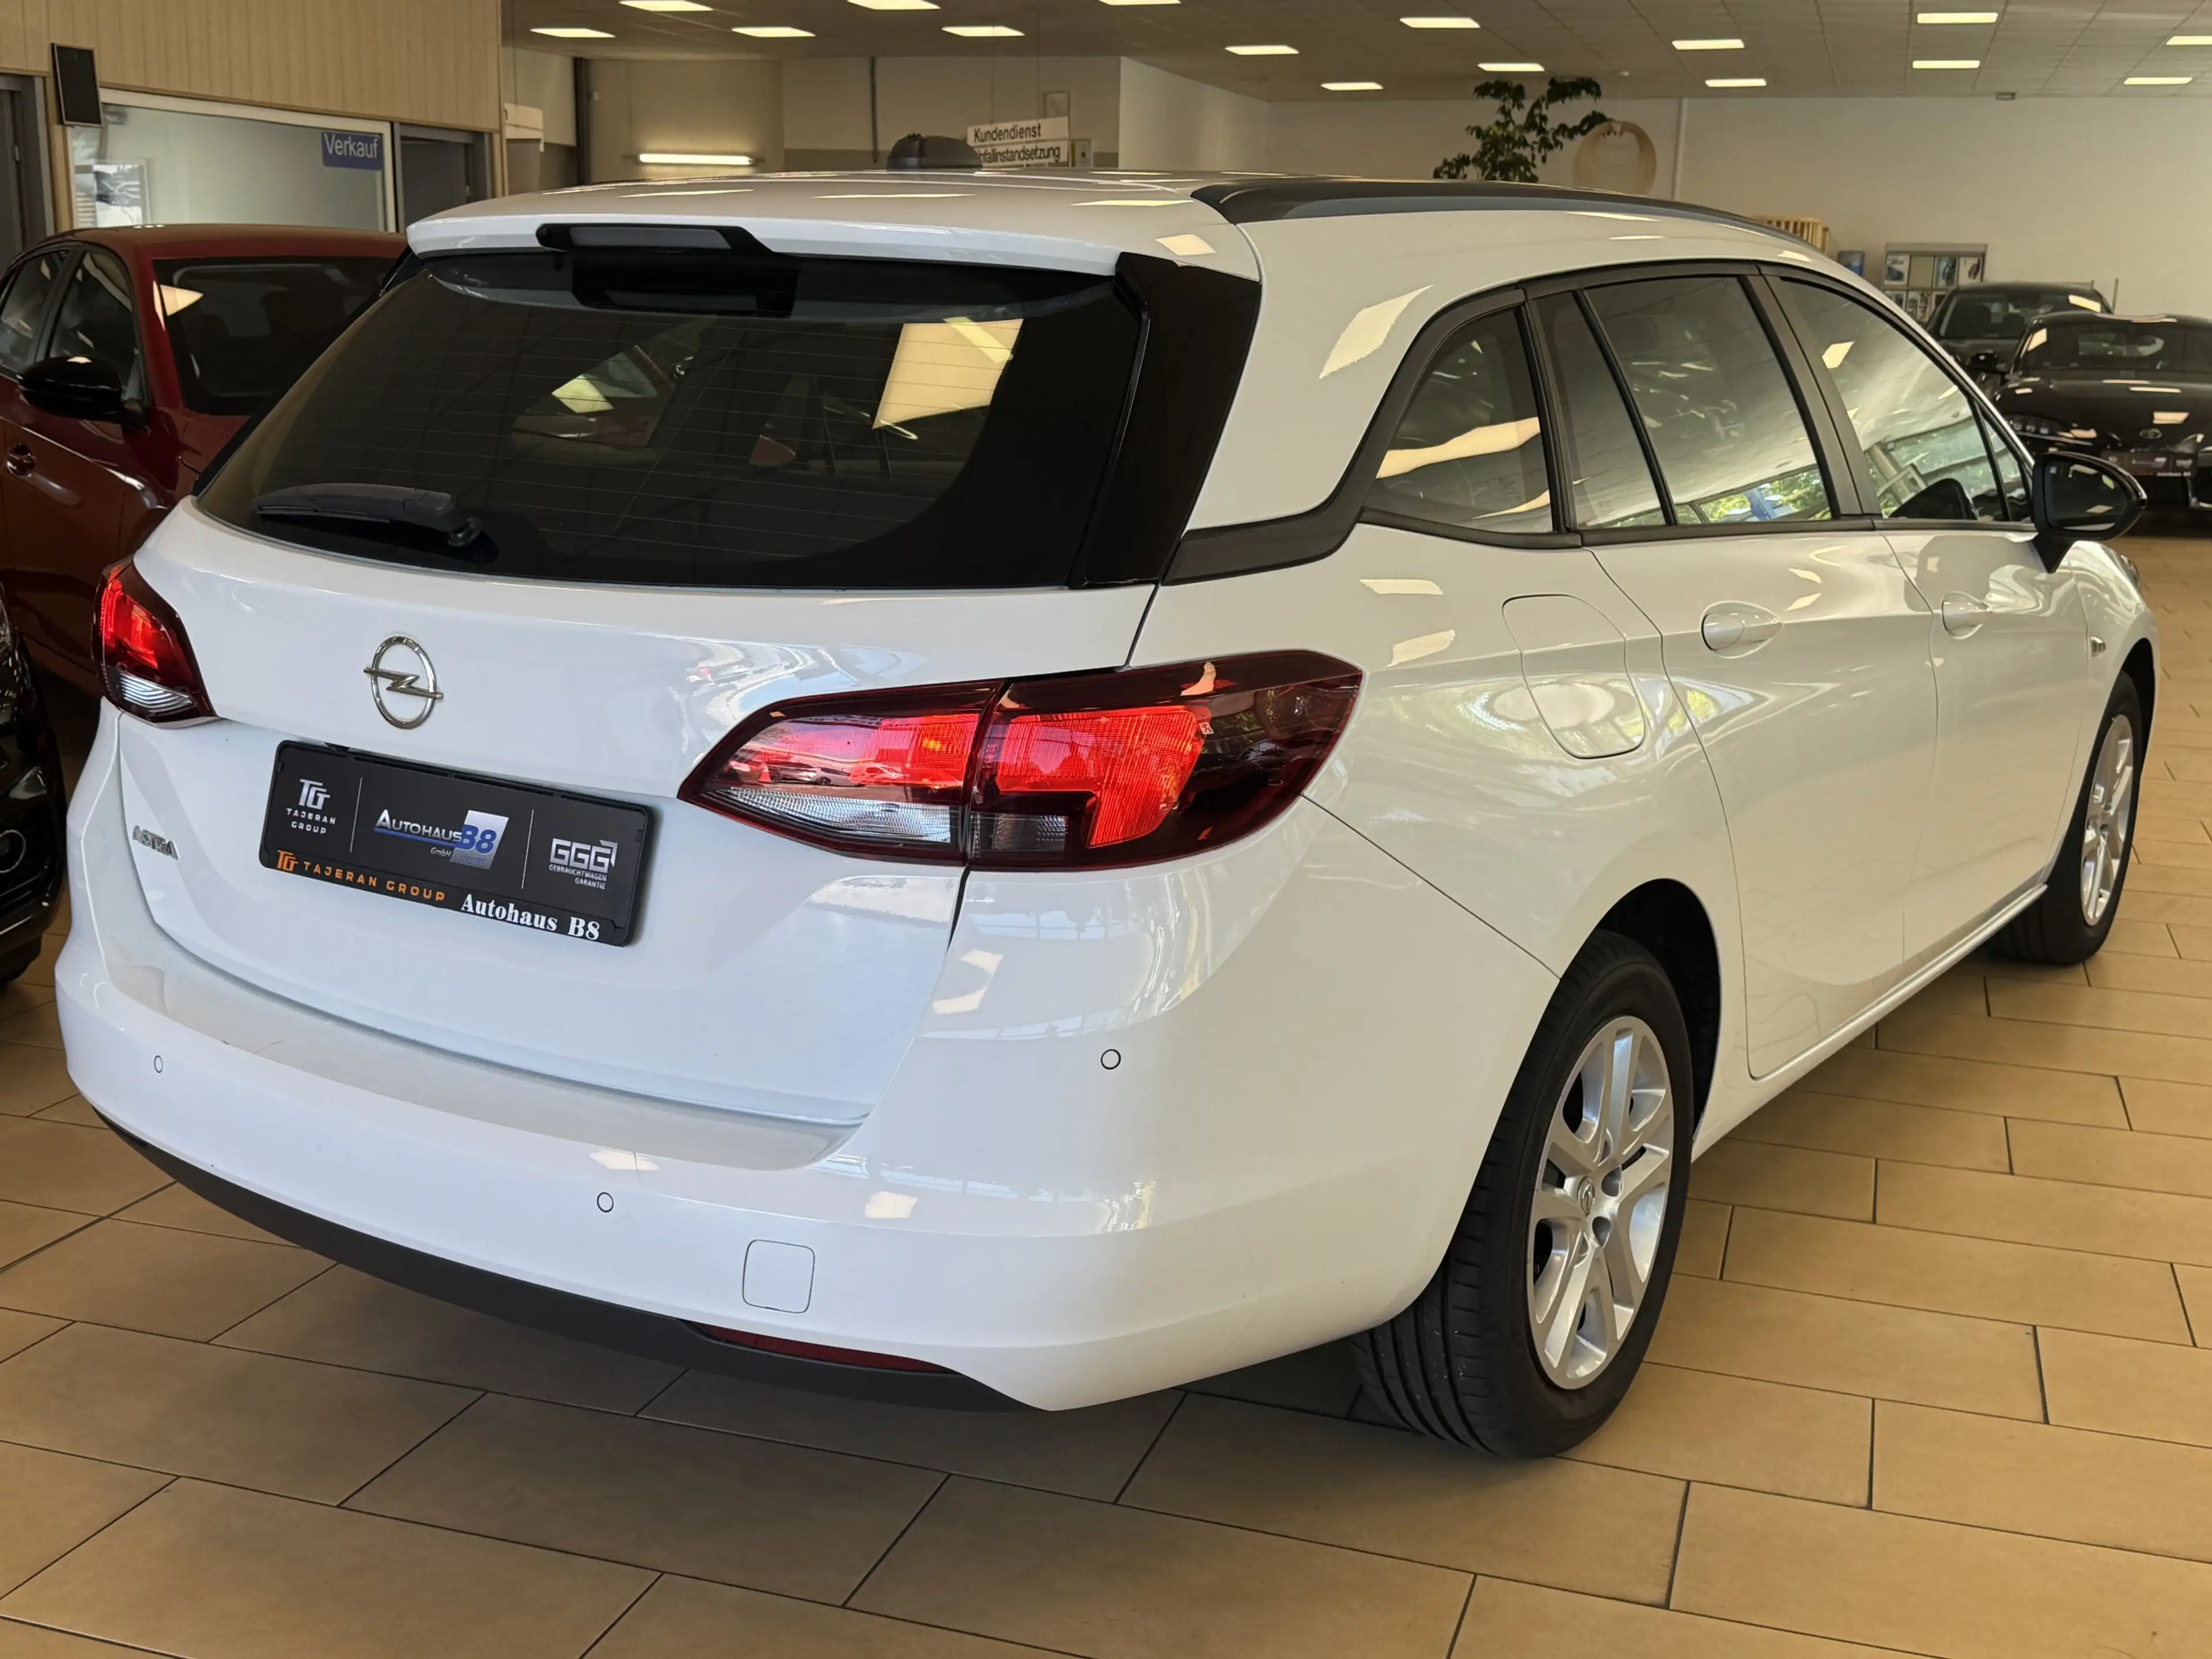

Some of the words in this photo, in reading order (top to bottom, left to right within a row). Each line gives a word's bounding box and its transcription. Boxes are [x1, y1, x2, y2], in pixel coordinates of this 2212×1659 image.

[973, 123, 1041, 143] Kundendienst
[324, 132, 378, 159] Verkauf
[978, 145, 1060, 163] nfallinstandsetzung
[286, 808, 336, 825] TAJERAN
[290, 821, 327, 835] GROUP
[132, 825, 179, 861] ASTRA
[460, 824, 497, 855] B8
[430, 847, 452, 857] GmbH
[550, 838, 612, 873] GGG
[303, 861, 378, 888] TAJERAN
[385, 880, 445, 902] GROUP
[548, 864, 607, 882] GEBRAUCHTWAGEN
[575, 877, 606, 890] GARANTIE
[461, 893, 558, 931] Autohaus
[567, 916, 601, 941] B8
